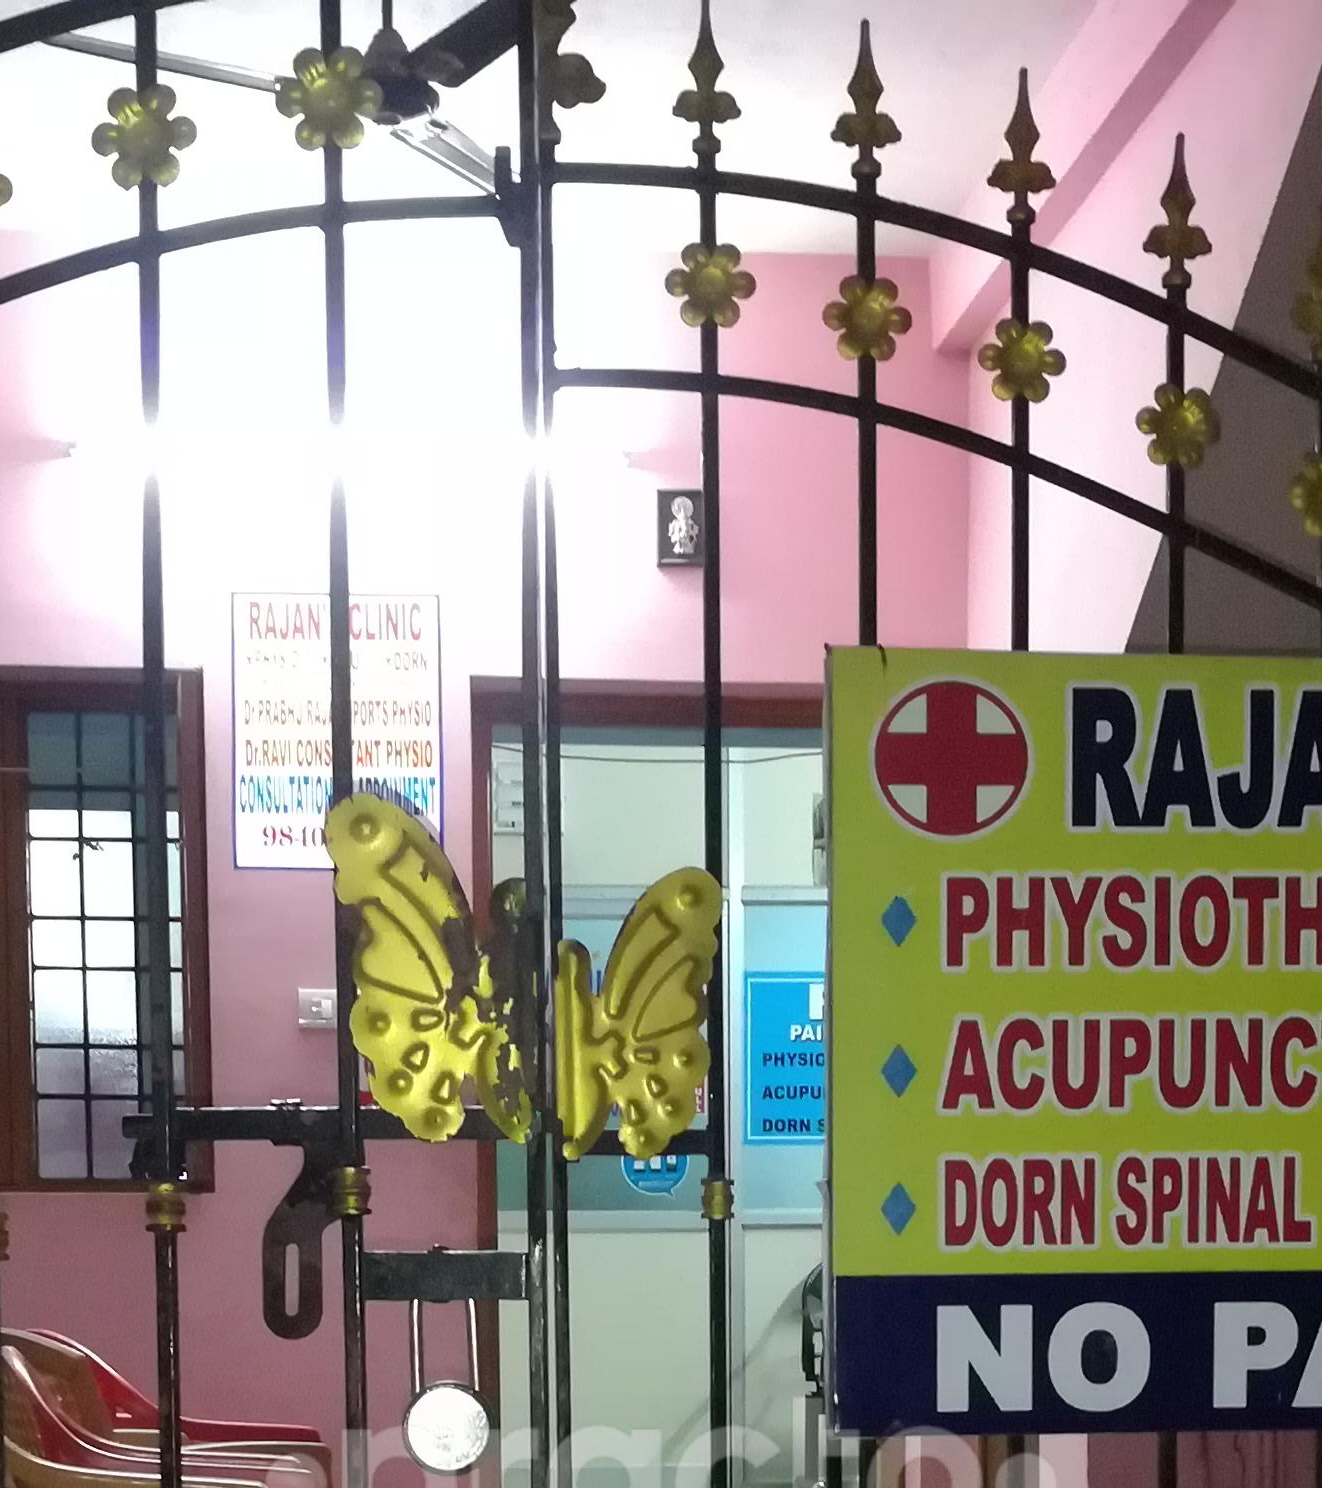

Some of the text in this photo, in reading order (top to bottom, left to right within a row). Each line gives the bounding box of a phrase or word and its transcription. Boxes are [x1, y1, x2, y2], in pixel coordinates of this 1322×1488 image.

[249, 602, 421, 641] RAJAN' CLINIC
[353, 700, 389, 727] PORTS
[392, 700, 432, 727] PHYSIO
[386, 740, 433, 768] PHYSIO
[240, 774, 333, 815] CONSULTATION
[790, 1024, 823, 1041] PAI
[762, 1085, 824, 1100] ACUPU
[762, 1118, 810, 1132] DORN
[943, 1155, 1096, 1247] DORN
[1115, 1155, 1312, 1244] SPINAL
[936, 1302, 1152, 1411] NO
